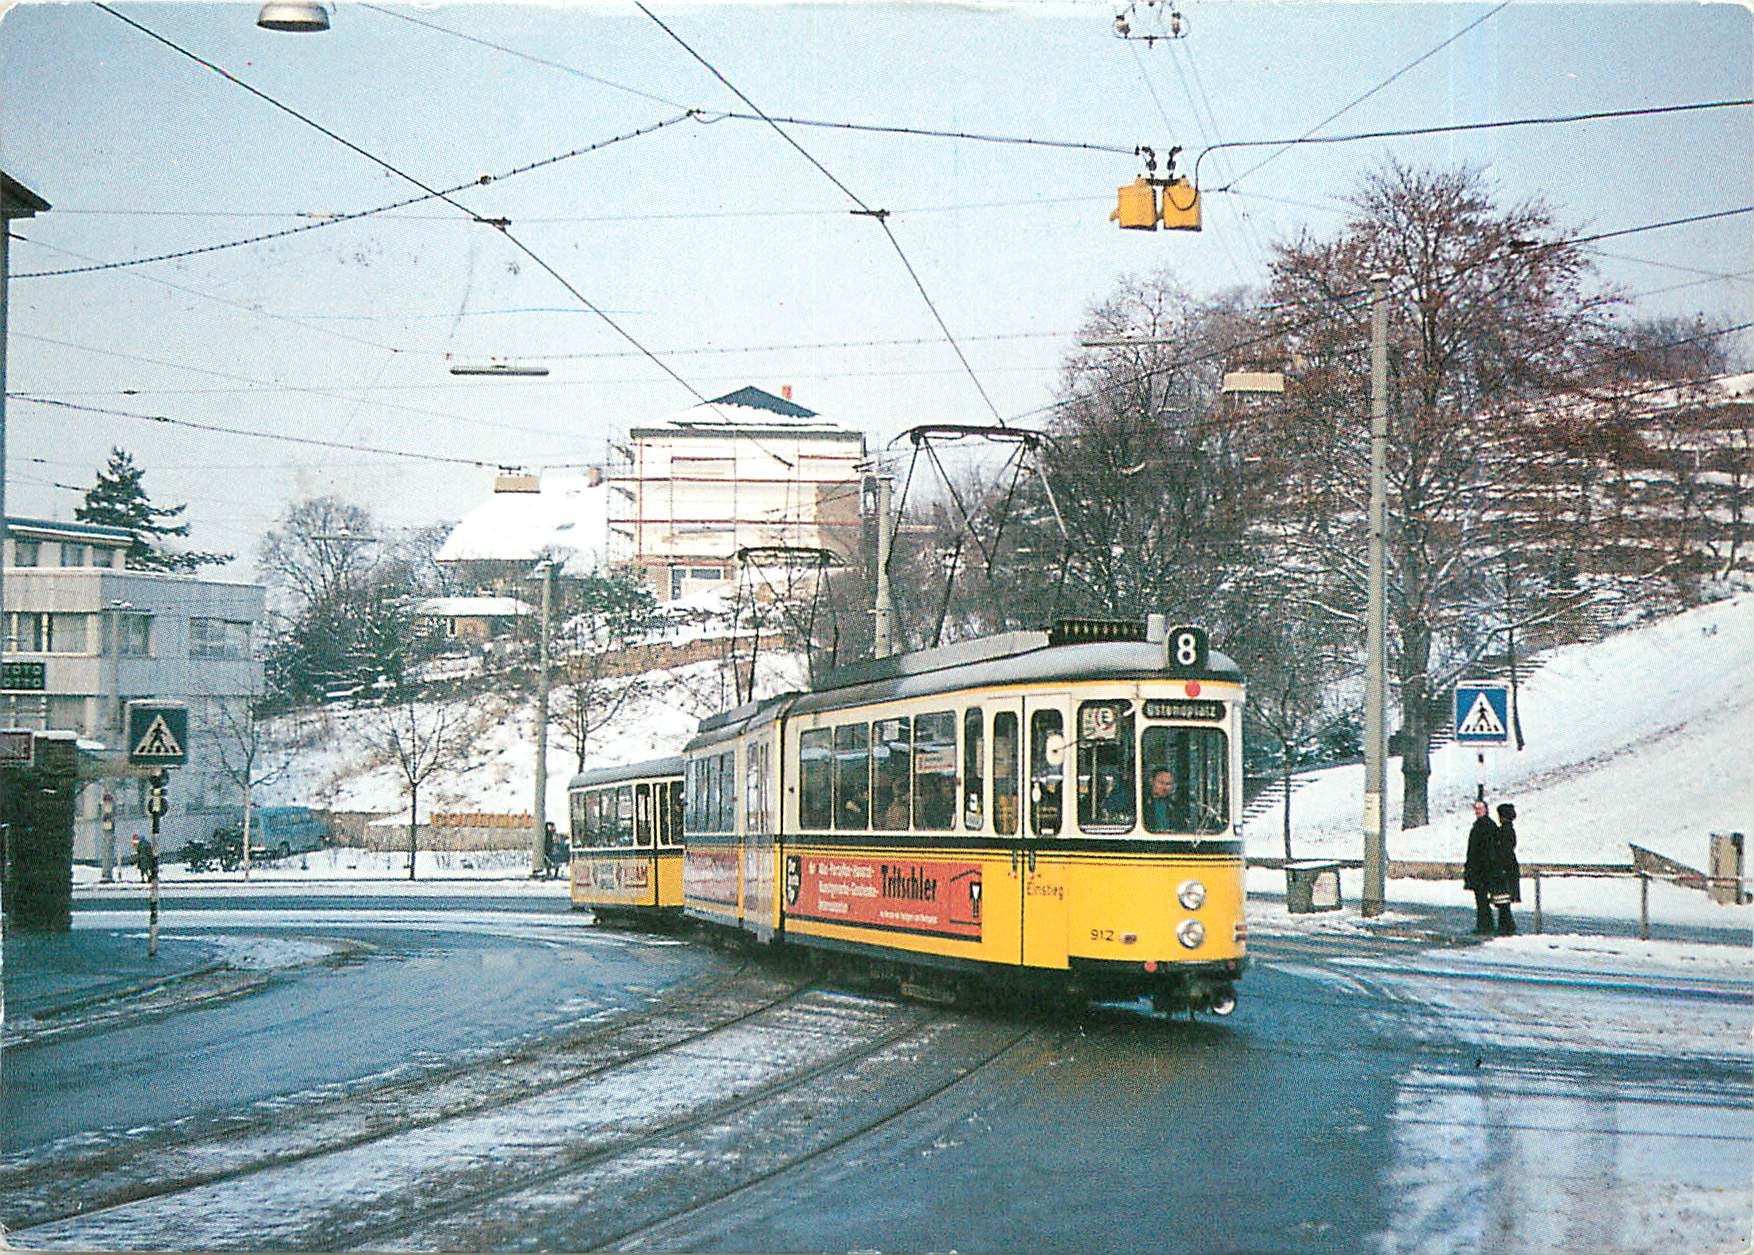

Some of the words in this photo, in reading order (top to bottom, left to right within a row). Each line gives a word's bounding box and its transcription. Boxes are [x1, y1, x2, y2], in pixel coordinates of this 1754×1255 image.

[1177, 633, 1197, 666] 8
[3, 678, 41, 688] OTTO
[880, 864, 938, 902] Tritschler
[1026, 881, 1064, 901] Einstieg
[1090, 928, 1115, 942] 912
